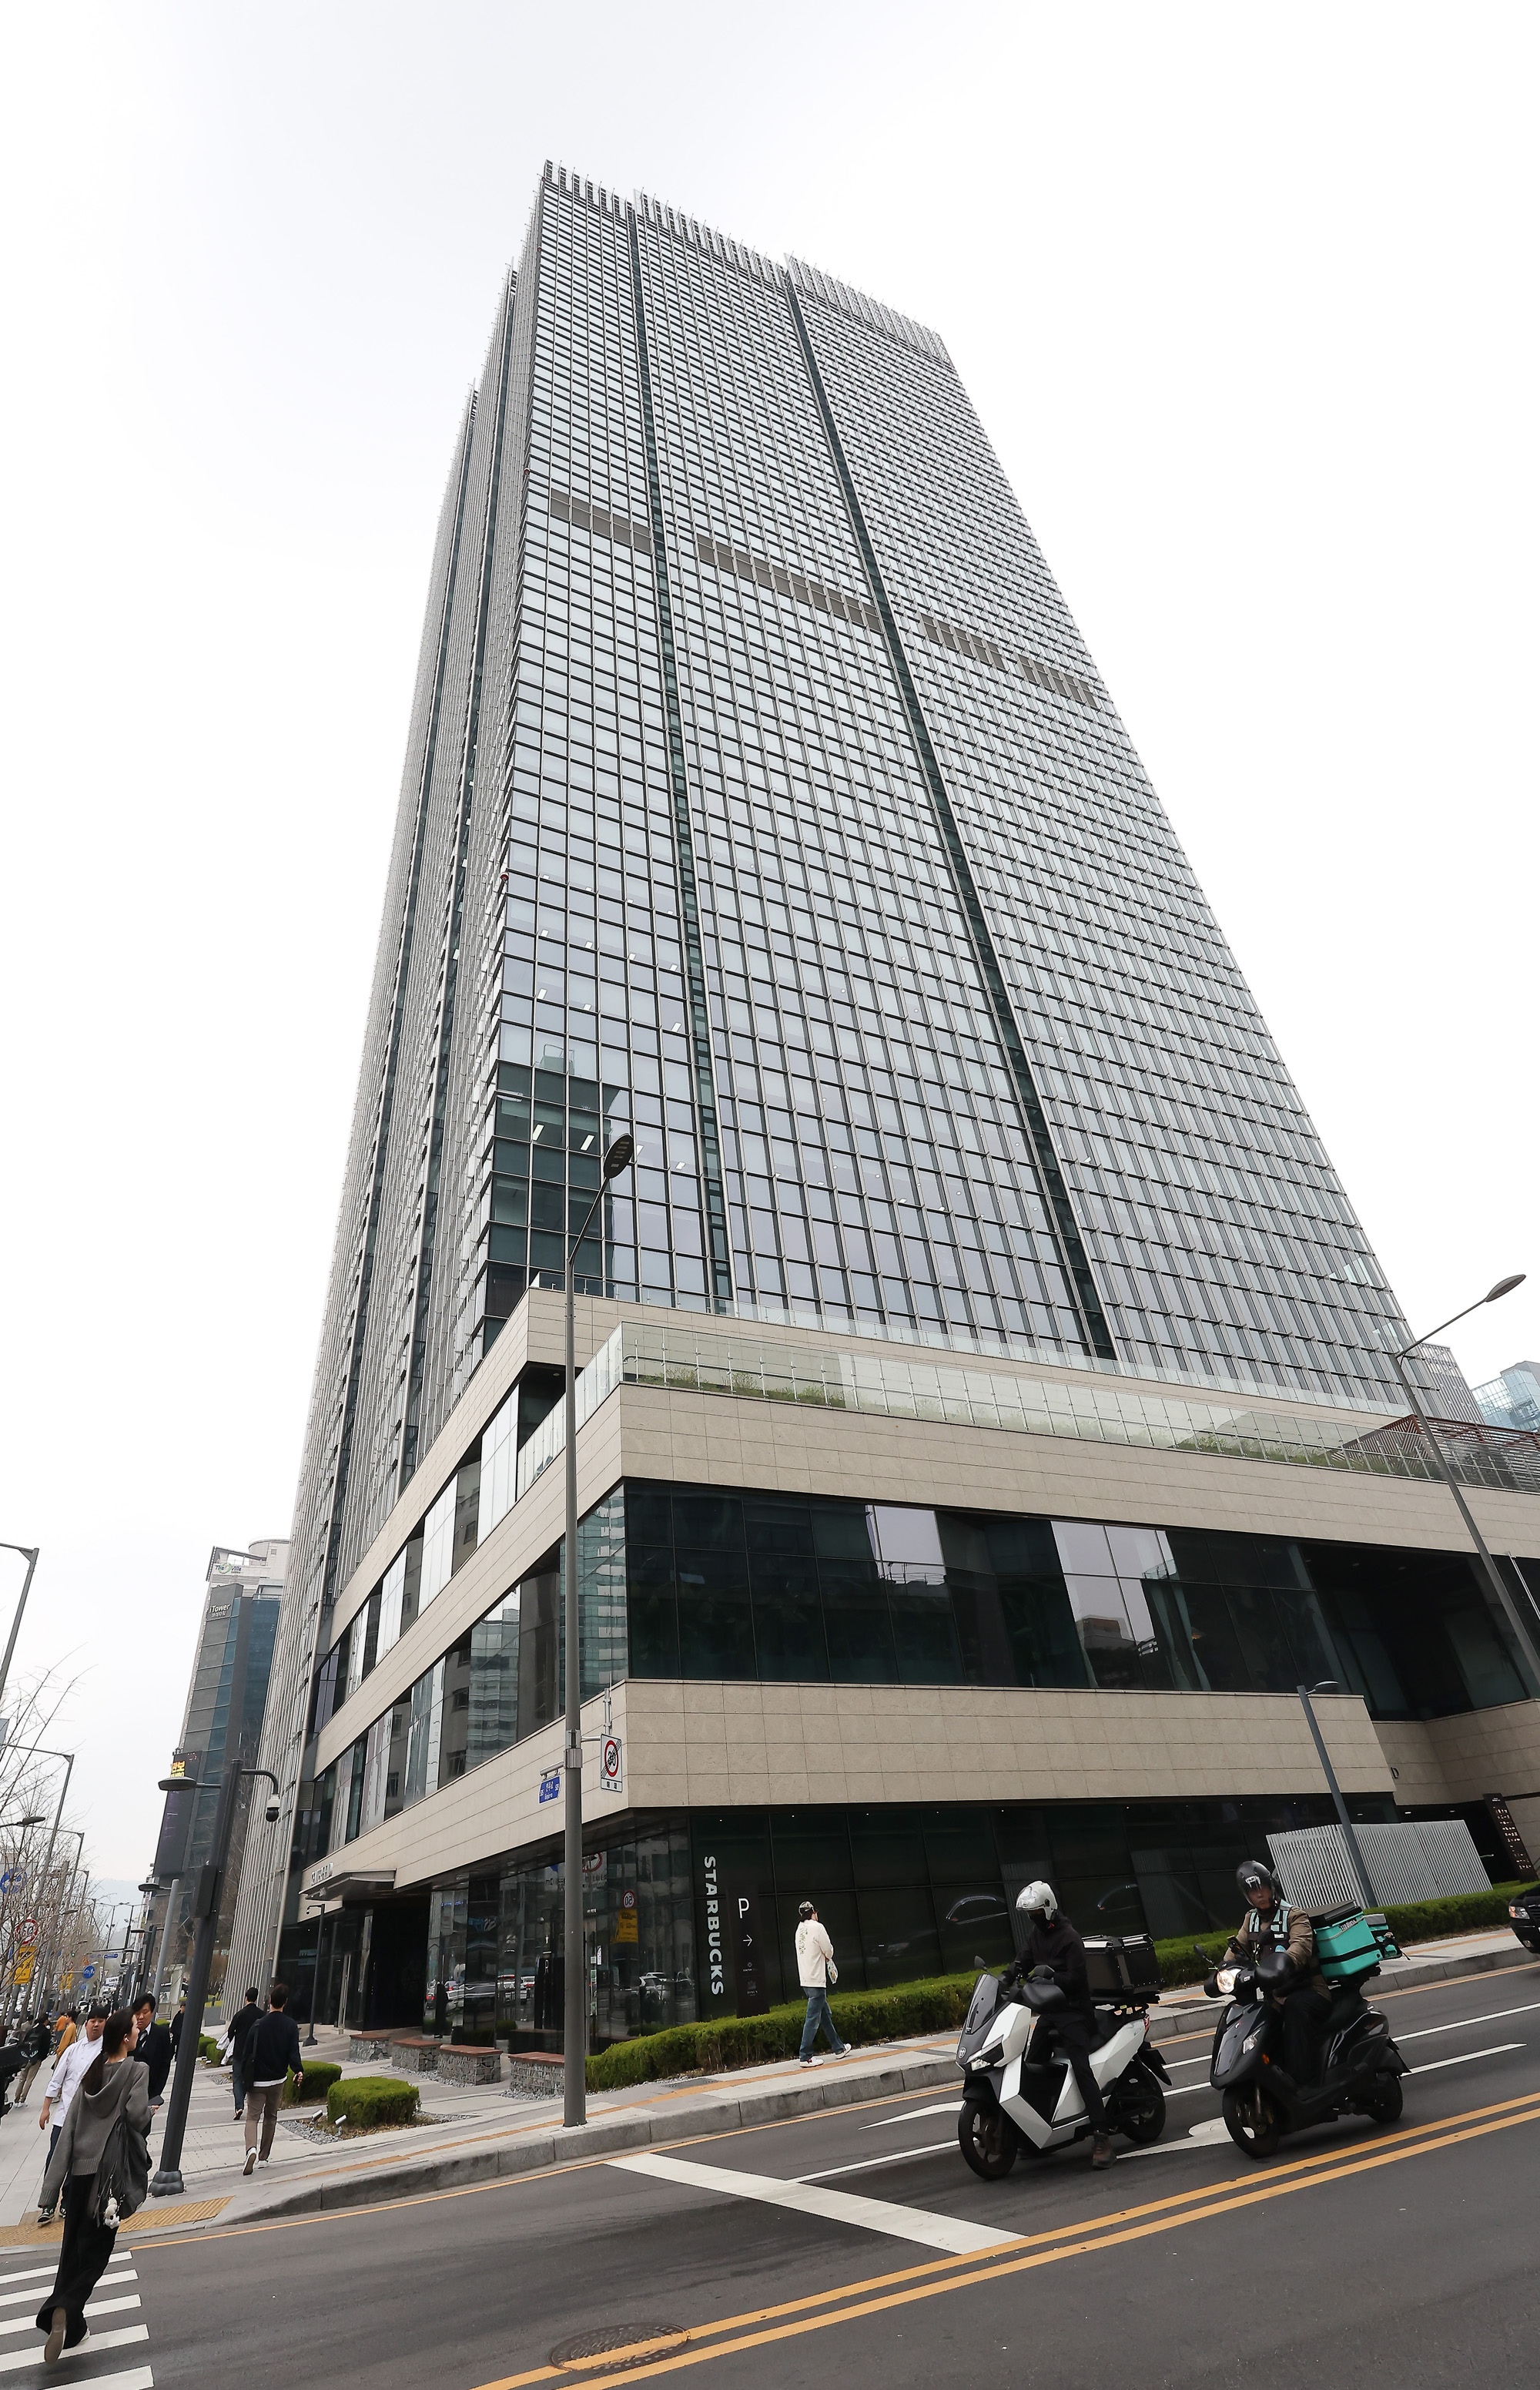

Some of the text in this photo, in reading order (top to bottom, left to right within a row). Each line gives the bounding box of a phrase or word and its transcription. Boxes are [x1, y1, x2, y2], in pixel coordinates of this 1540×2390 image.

[209, 1604, 231, 1614] iTower
[738, 1898, 750, 1919] P
[704, 1855, 724, 1995] STARBUCKS
